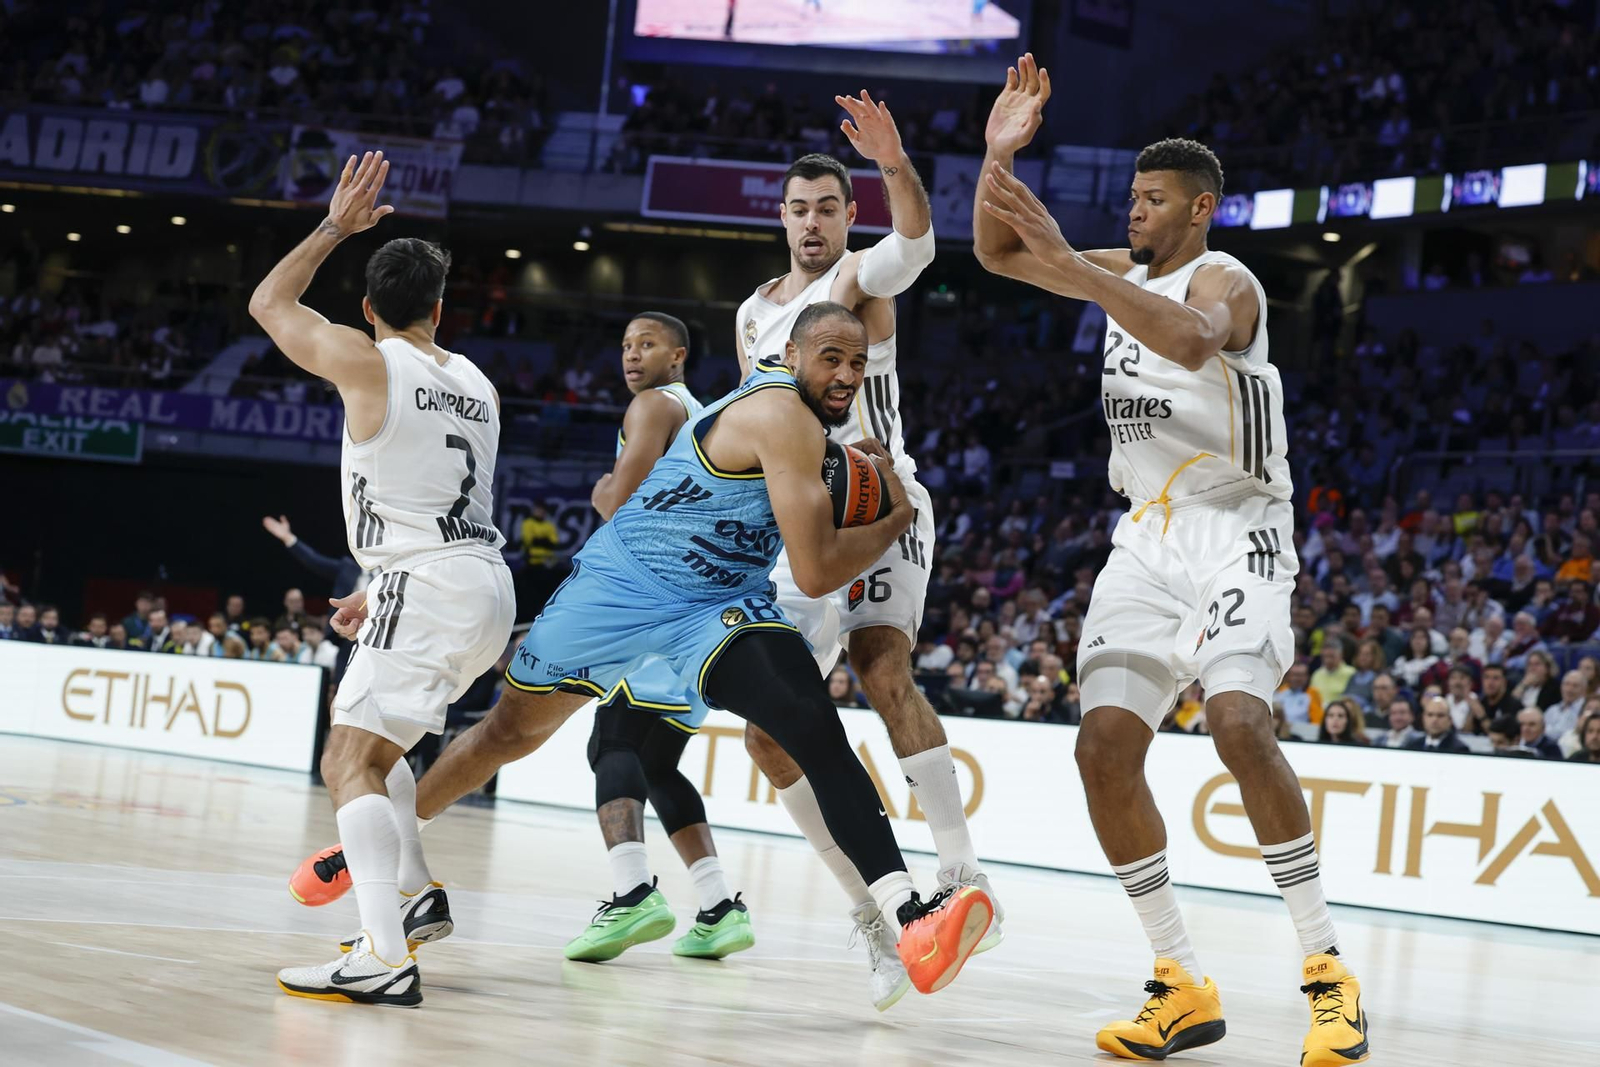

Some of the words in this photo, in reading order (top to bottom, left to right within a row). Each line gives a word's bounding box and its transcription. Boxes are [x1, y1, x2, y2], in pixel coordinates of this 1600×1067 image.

[1104, 330, 1140, 378] 22
[58, 387, 177, 424] REAL
[415, 387, 490, 424] CAMPAZZO
[23, 428, 89, 451] EXIT
[446, 433, 477, 519] 7
[868, 566, 893, 603] 6
[1206, 588, 1246, 641] 22
[61, 668, 252, 739] ETIHAD
